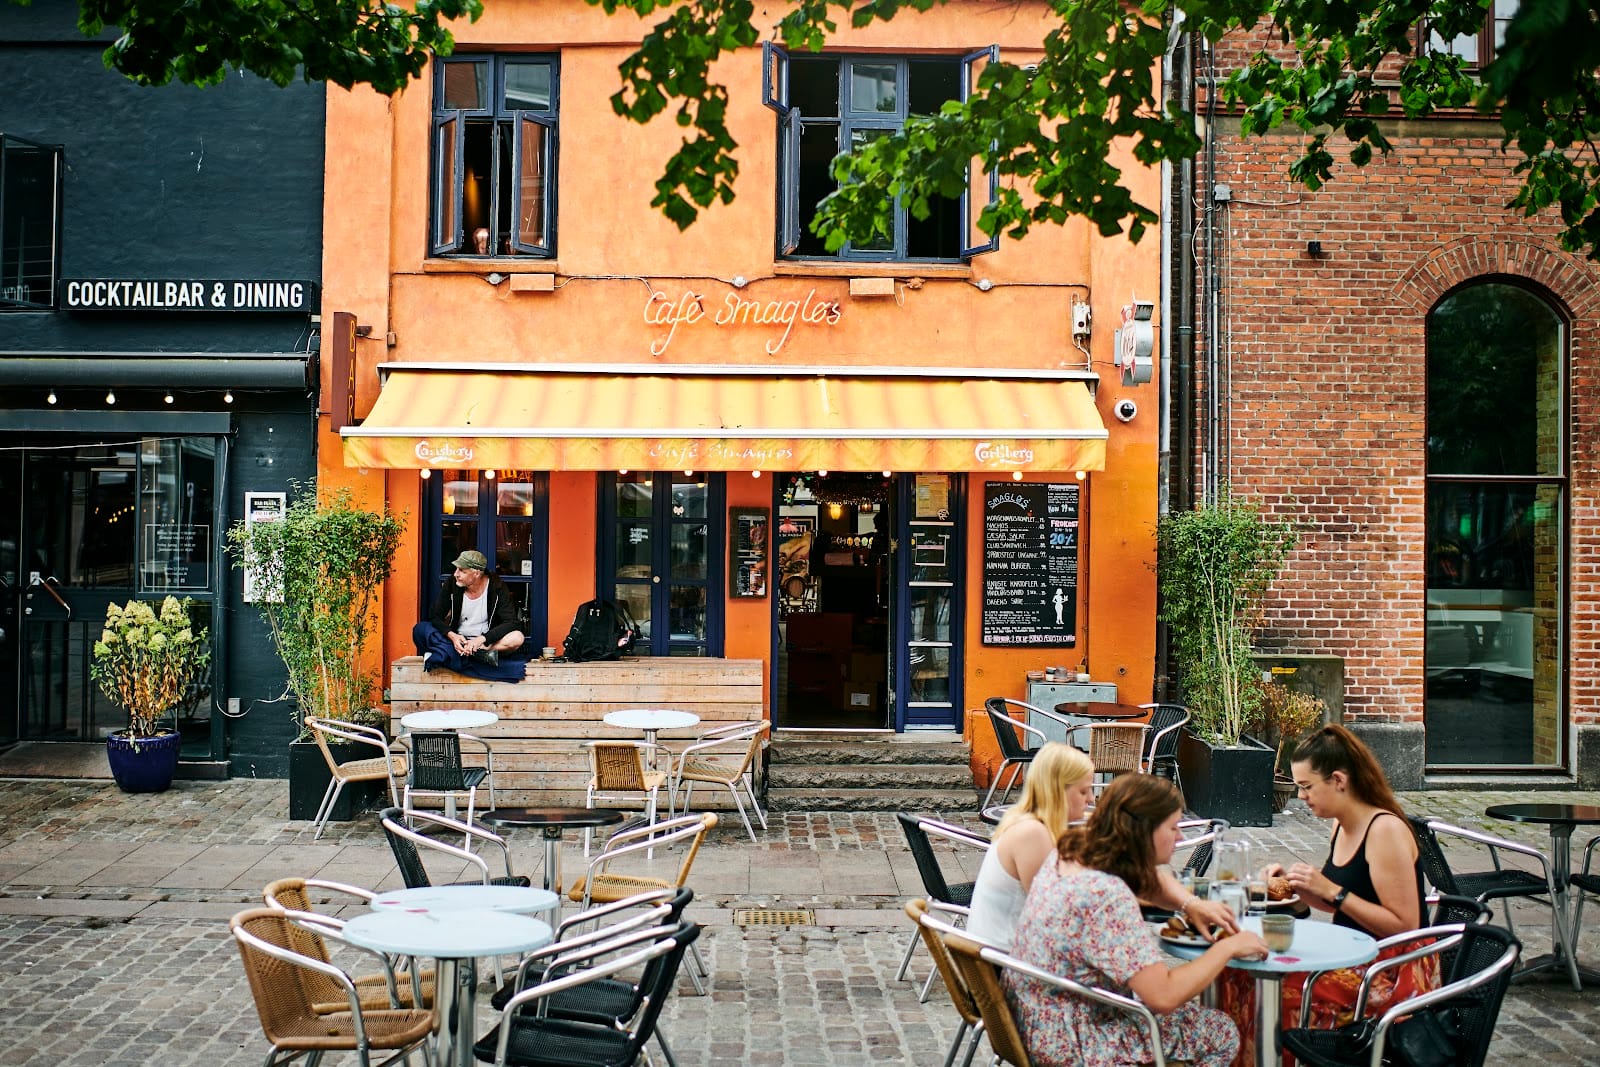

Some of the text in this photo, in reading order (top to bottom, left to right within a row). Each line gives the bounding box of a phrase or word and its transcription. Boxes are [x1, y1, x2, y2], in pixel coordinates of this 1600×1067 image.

[67, 281, 303, 307] COCKTAILBAR & DINING
[643, 288, 842, 356] Café Smagløs
